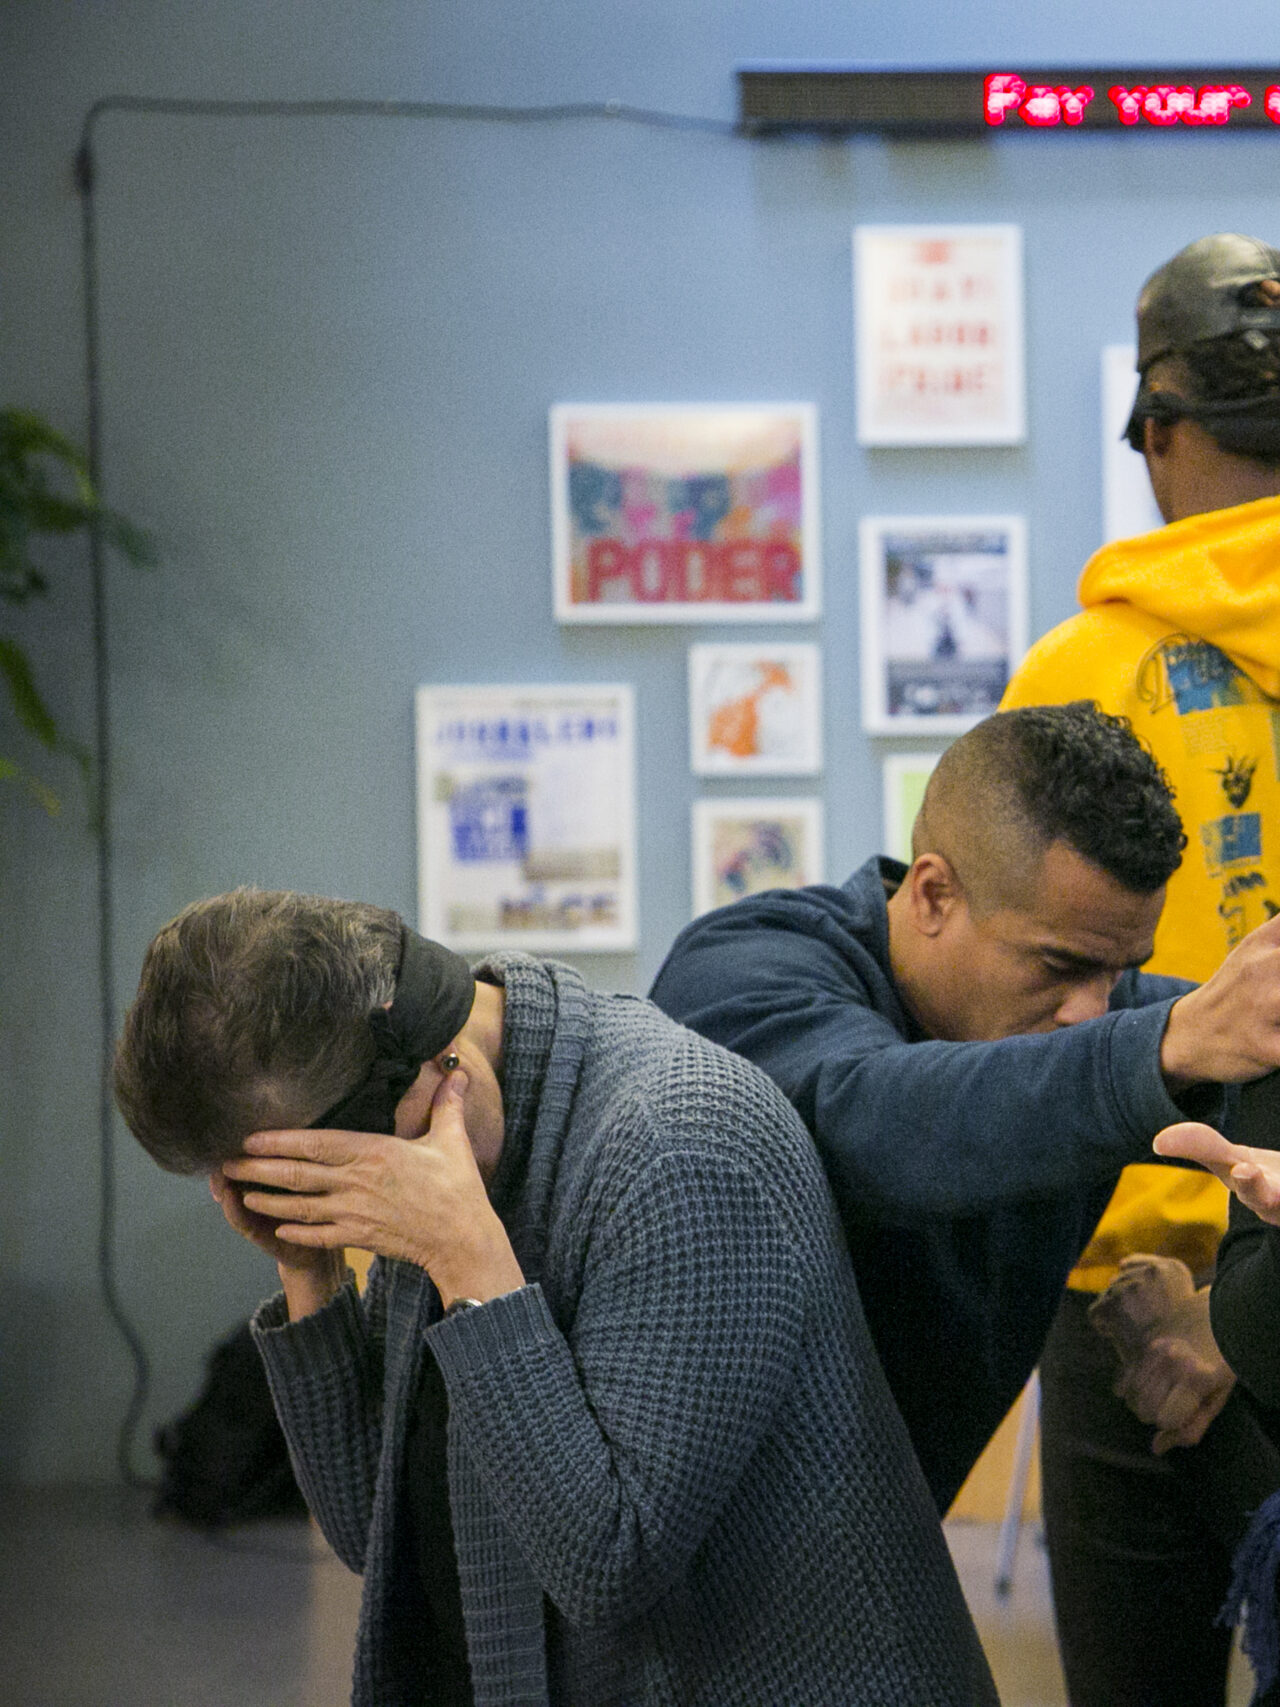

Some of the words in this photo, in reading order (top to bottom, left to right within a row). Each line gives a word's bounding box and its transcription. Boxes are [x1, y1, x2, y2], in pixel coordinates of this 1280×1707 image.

[984, 72, 1095, 126] Pay
[1107, 83, 1252, 126] your
[584, 537, 804, 604] PODER
